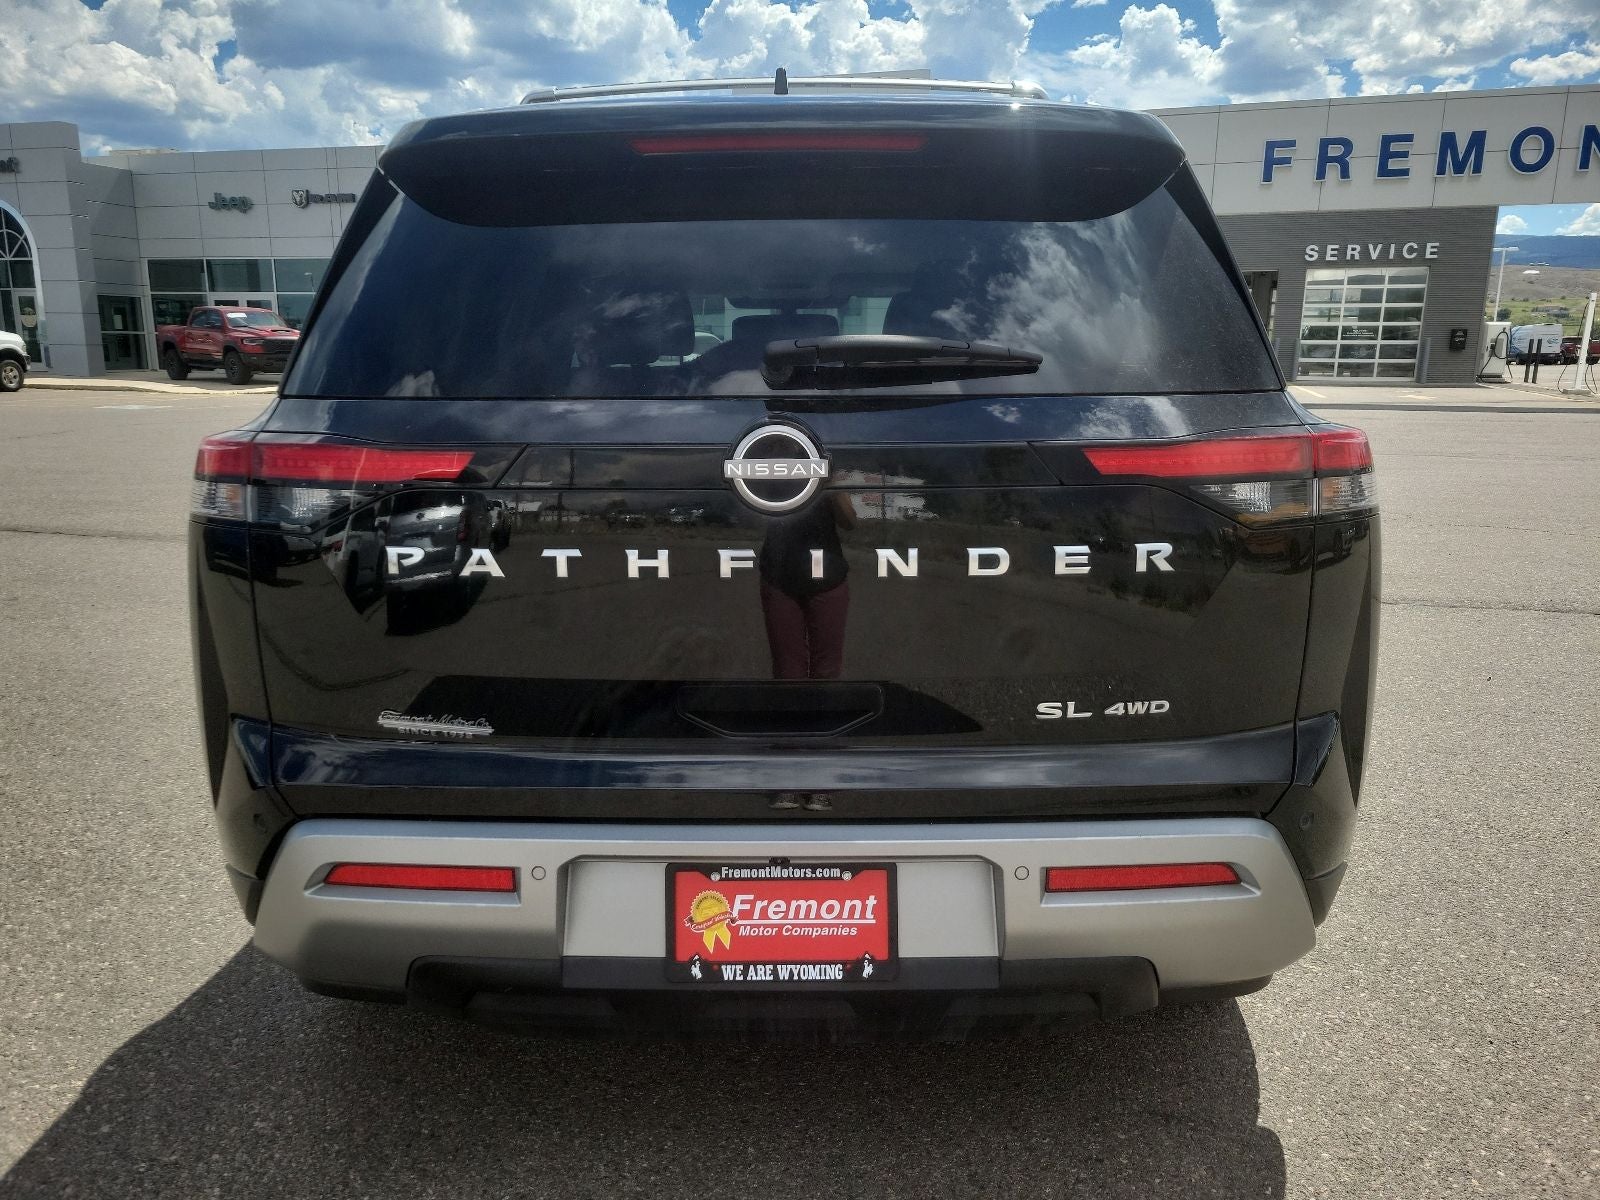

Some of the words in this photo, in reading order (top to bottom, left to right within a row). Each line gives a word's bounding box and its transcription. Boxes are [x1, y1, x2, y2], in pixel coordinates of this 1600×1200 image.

[207, 192, 252, 214] Jeep
[1304, 242, 1440, 262] SERVICE
[727, 463, 825, 476] NISSAN
[385, 542, 1175, 579] PATHFINDER
[1036, 701, 1093, 719] SL
[1104, 700, 1170, 716] 4WD
[721, 866, 841, 879] FremontMotors.com
[733, 894, 877, 920] Fremont
[739, 925, 778, 937] Motor
[782, 925, 858, 938] Companies
[721, 964, 744, 981] WE
[746, 964, 774, 981] ARE
[776, 964, 844, 981] WYOMING
